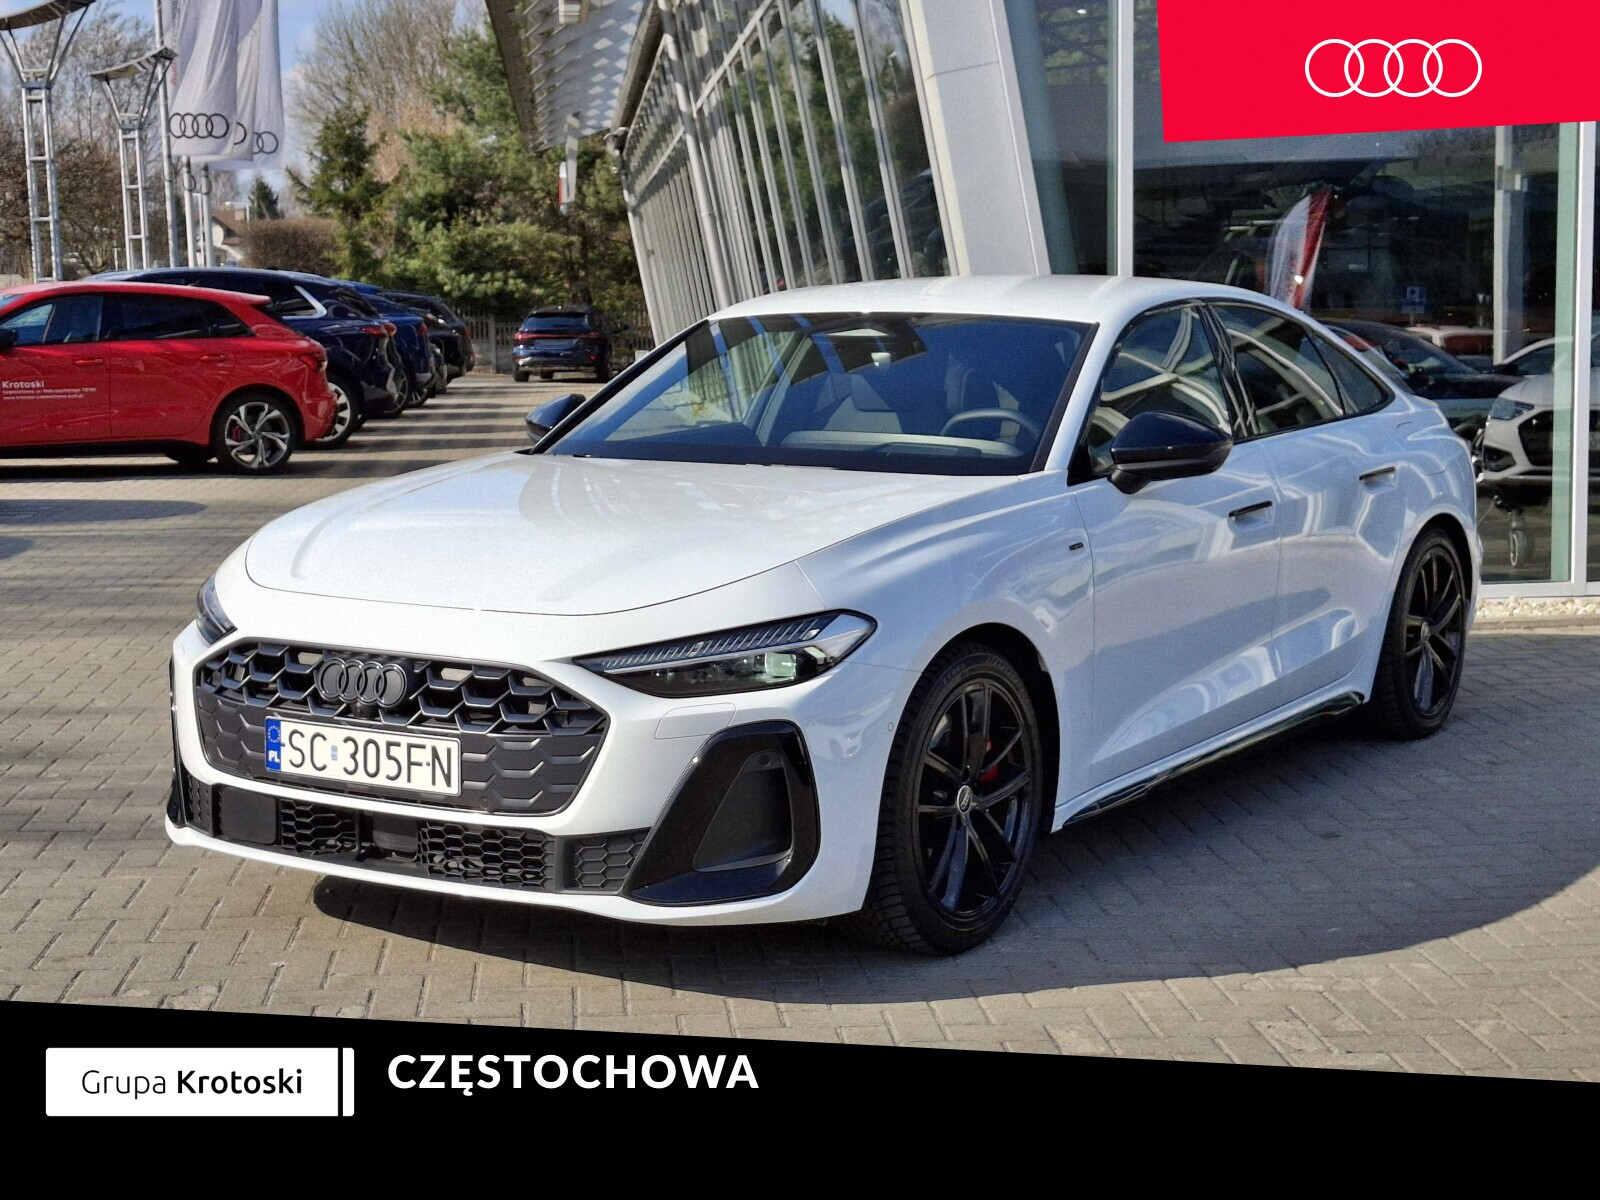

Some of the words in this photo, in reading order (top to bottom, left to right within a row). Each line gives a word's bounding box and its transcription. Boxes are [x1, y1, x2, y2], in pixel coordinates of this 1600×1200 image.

[2, 380, 44, 389] Krotoski
[268, 750, 280, 762] PL
[288, 728, 327, 771] SC
[343, 736, 451, 788] 305FN
